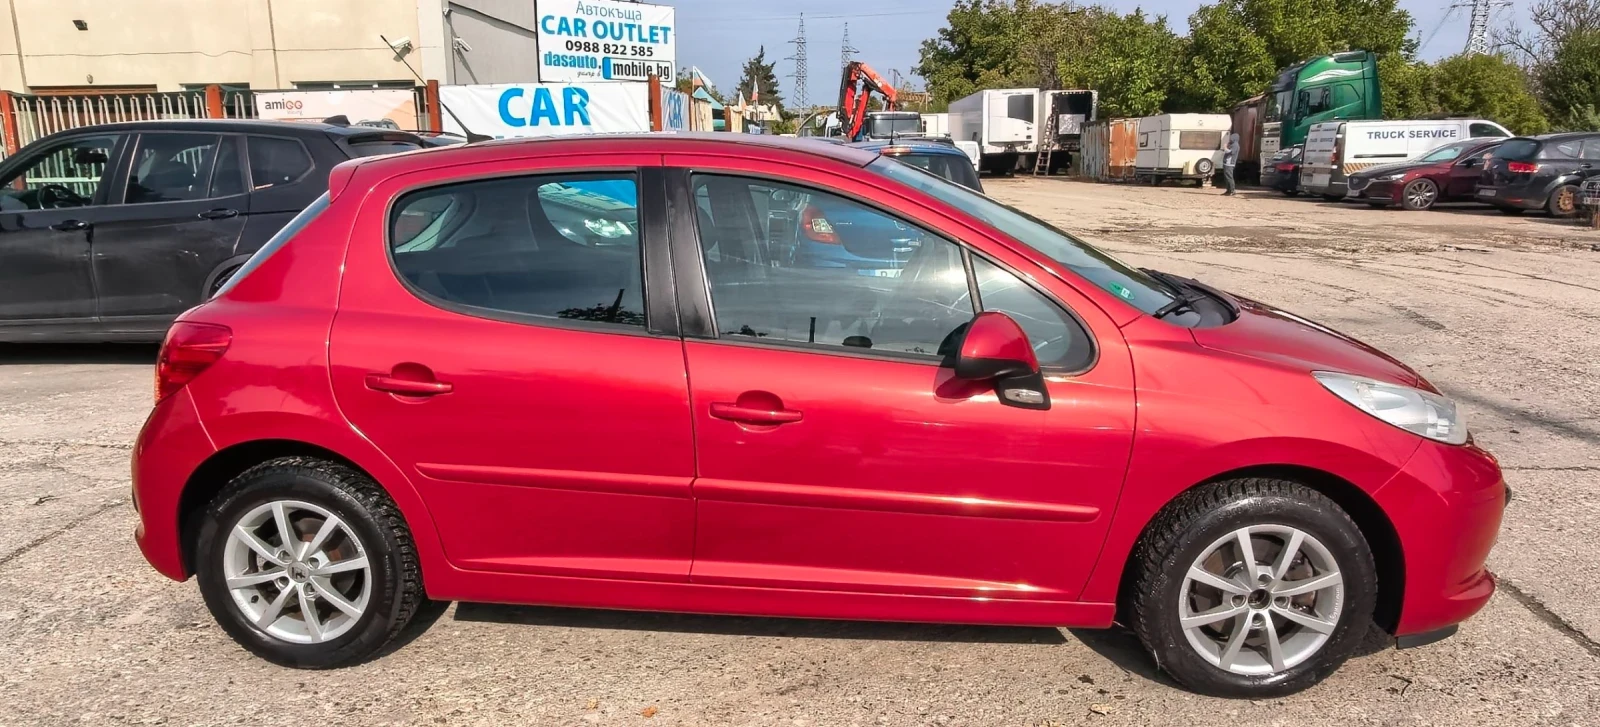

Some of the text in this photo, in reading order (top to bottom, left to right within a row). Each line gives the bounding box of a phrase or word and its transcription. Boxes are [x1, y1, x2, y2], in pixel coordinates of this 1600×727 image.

[576, 1, 642, 22] Автокъща
[541, 15, 671, 44] CAR OUTLET
[565, 40, 654, 57] 0988 822 585
[613, 61, 670, 80] mobilebg
[498, 87, 592, 128] CAR
[1367, 129, 1457, 140] TRUCK SERVICE
